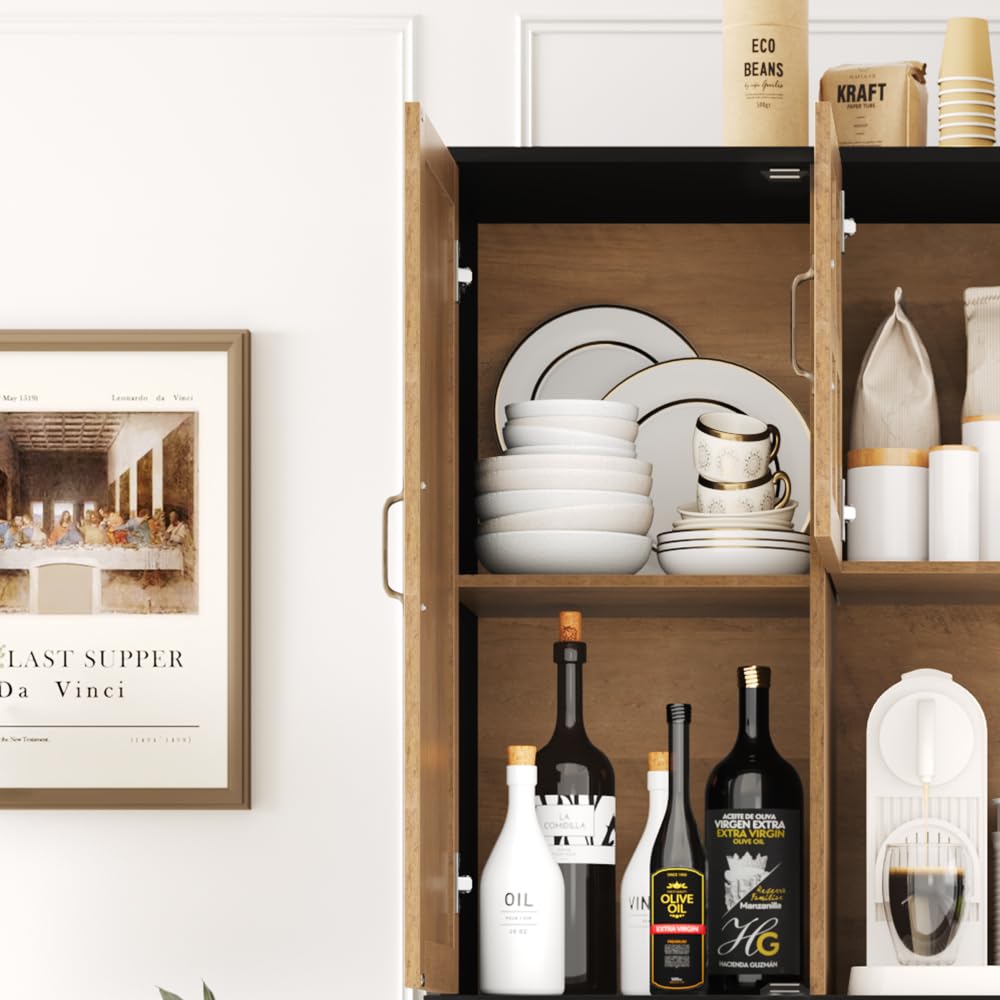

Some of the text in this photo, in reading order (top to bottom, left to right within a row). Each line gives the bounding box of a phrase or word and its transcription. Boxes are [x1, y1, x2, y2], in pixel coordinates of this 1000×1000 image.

[752, 38, 775, 53] ECO
[744, 62, 784, 77] BEANS
[837, 83, 887, 103] KRAFT
[8, 650, 183, 668] LAST SUPPER
[0, 681, 125, 698] Da Vinci
[714, 820, 785, 829] VIRGEN EXTRA
[717, 829, 785, 838] EXTRA VIRGIN
[505, 892, 534, 907] OIL
[660, 894, 694, 904] OLIVE
[667, 904, 687, 914] OIL
[656, 925, 699, 933] EXTRA VIRGIN
